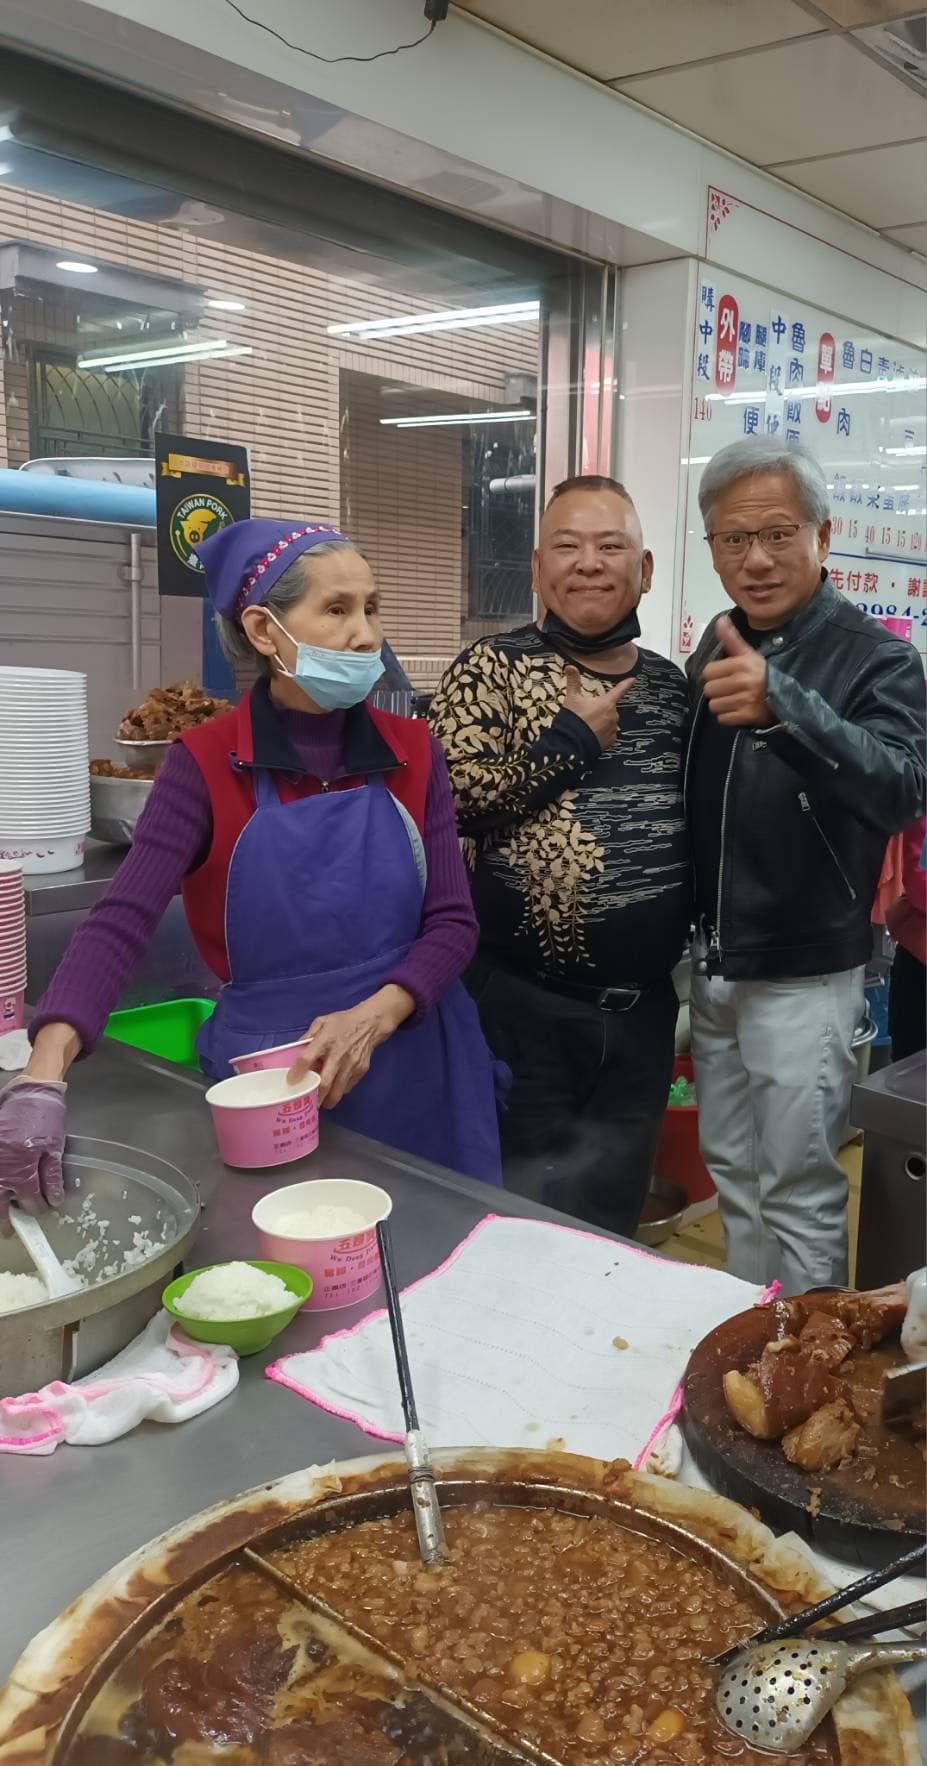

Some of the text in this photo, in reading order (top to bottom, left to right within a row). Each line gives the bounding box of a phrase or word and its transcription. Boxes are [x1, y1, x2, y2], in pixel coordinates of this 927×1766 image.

[718, 308, 736, 384] 外帶
[176, 498, 228, 520] TAIWAN PORK
[848, 519, 858, 538] 15
[865, 526, 875, 544] 40
[881, 527, 891, 545] 15
[896, 529, 906, 548] 15
[829, 568, 879, 593] 先付款
